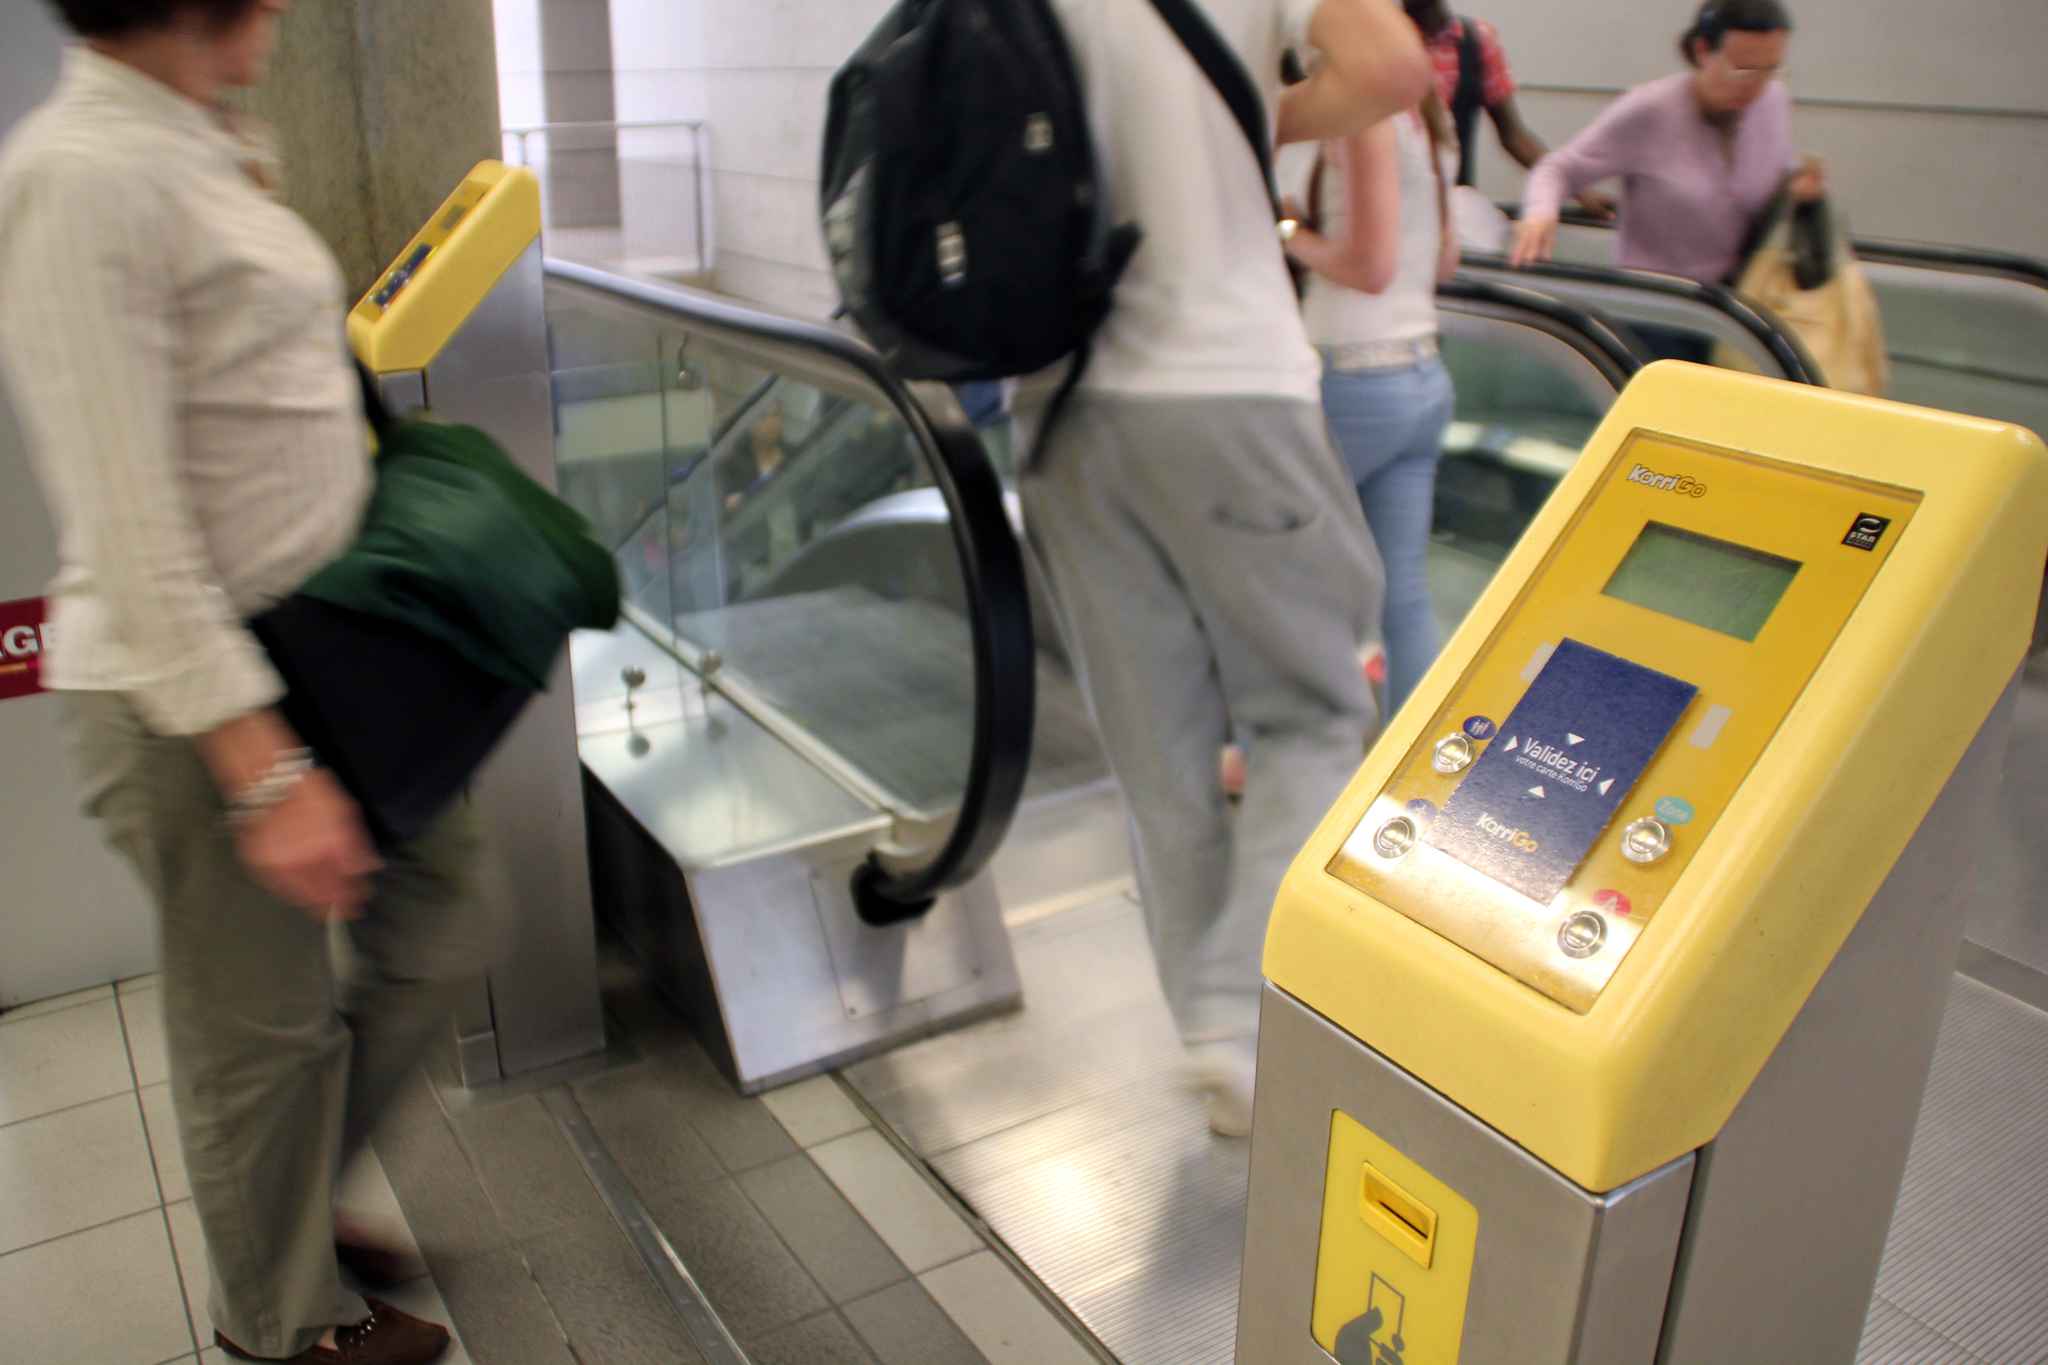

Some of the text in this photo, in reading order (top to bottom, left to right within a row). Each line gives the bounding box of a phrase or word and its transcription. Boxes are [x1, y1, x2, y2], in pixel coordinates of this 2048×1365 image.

[1626, 463, 1707, 498] KorriGo
[1515, 755, 1536, 770] votre
[1535, 764, 1558, 779] carte
[1522, 737, 1601, 783] Validez ici
[1475, 811, 1538, 853] KorriGo
